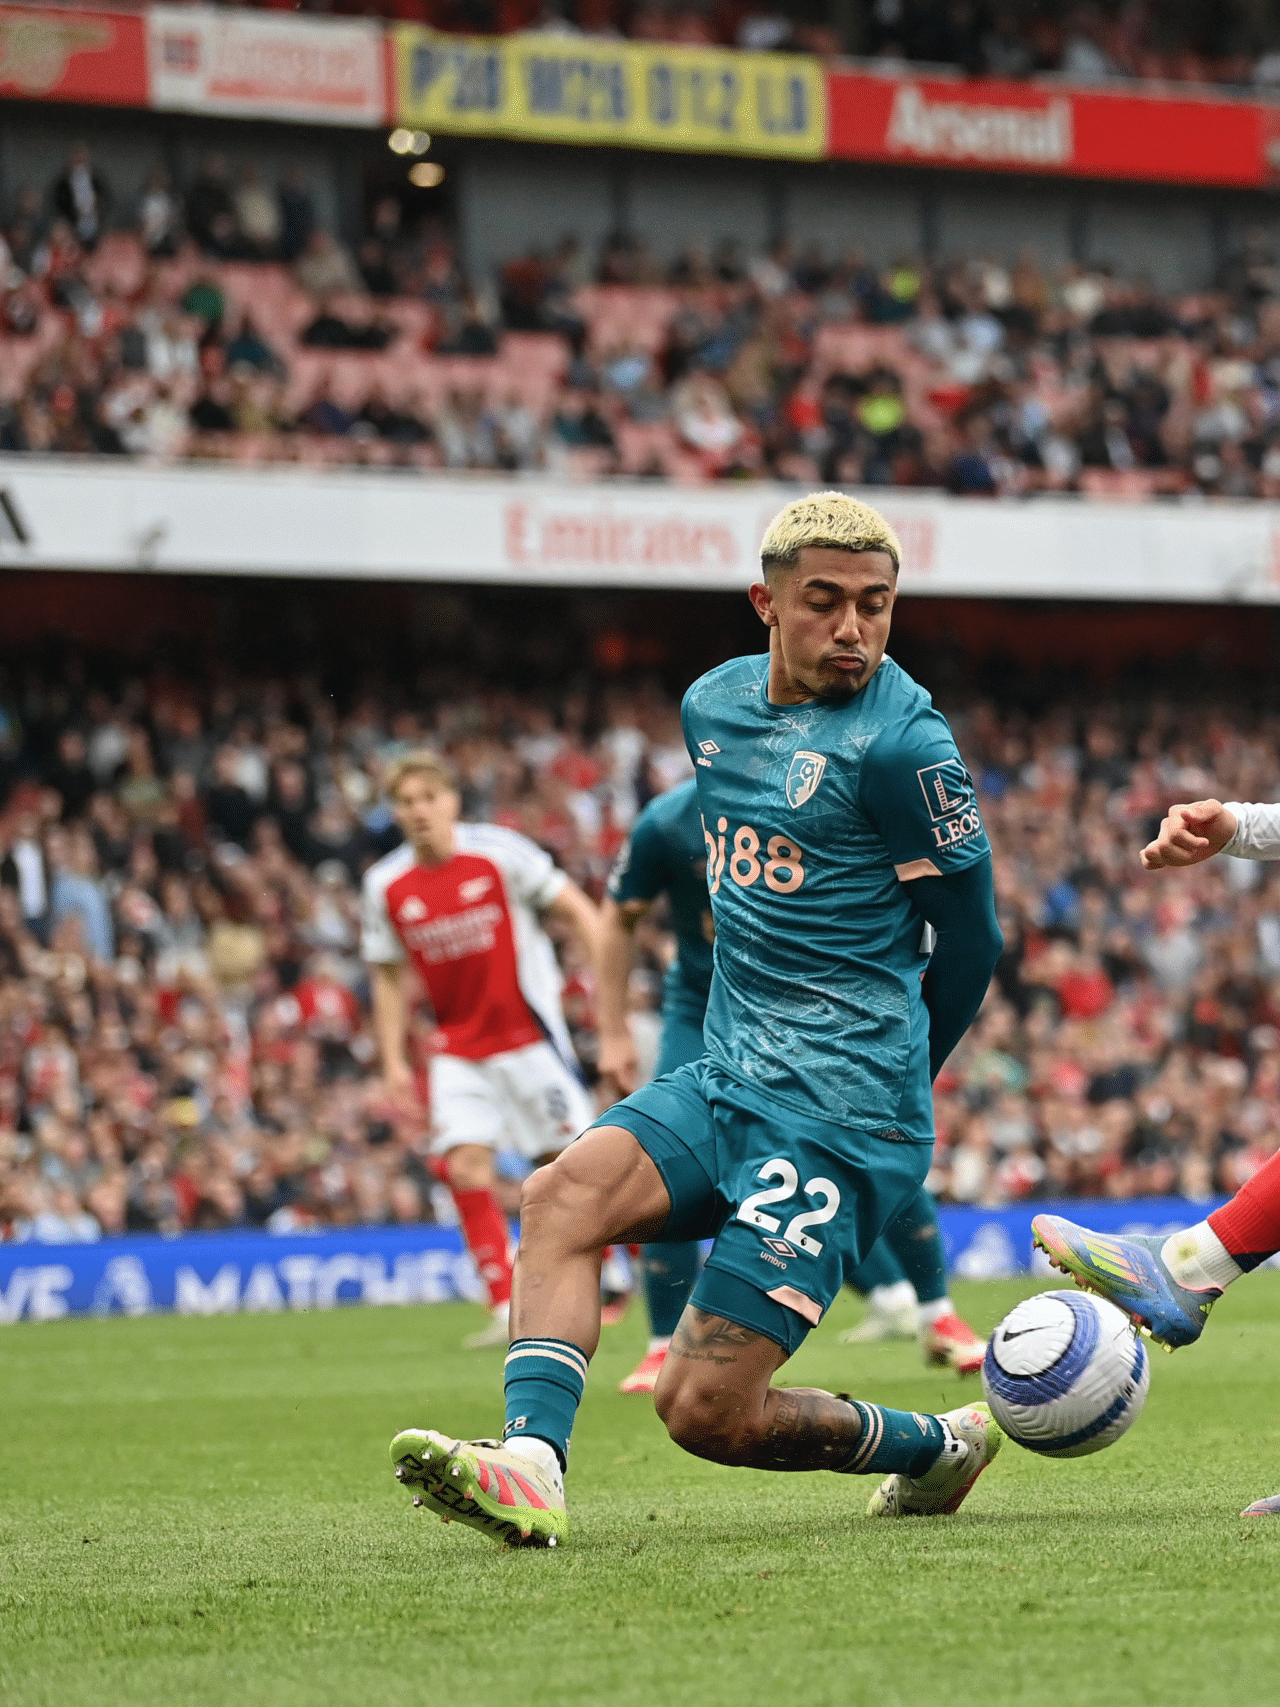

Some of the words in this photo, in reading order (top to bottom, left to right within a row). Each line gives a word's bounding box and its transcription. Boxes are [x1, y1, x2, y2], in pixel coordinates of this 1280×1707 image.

[886, 84, 1072, 166] Arsenal
[503, 501, 742, 568] Emirates
[931, 807, 980, 848] LEOS
[736, 1158, 841, 1257] 22
[760, 1250, 787, 1270] umbro
